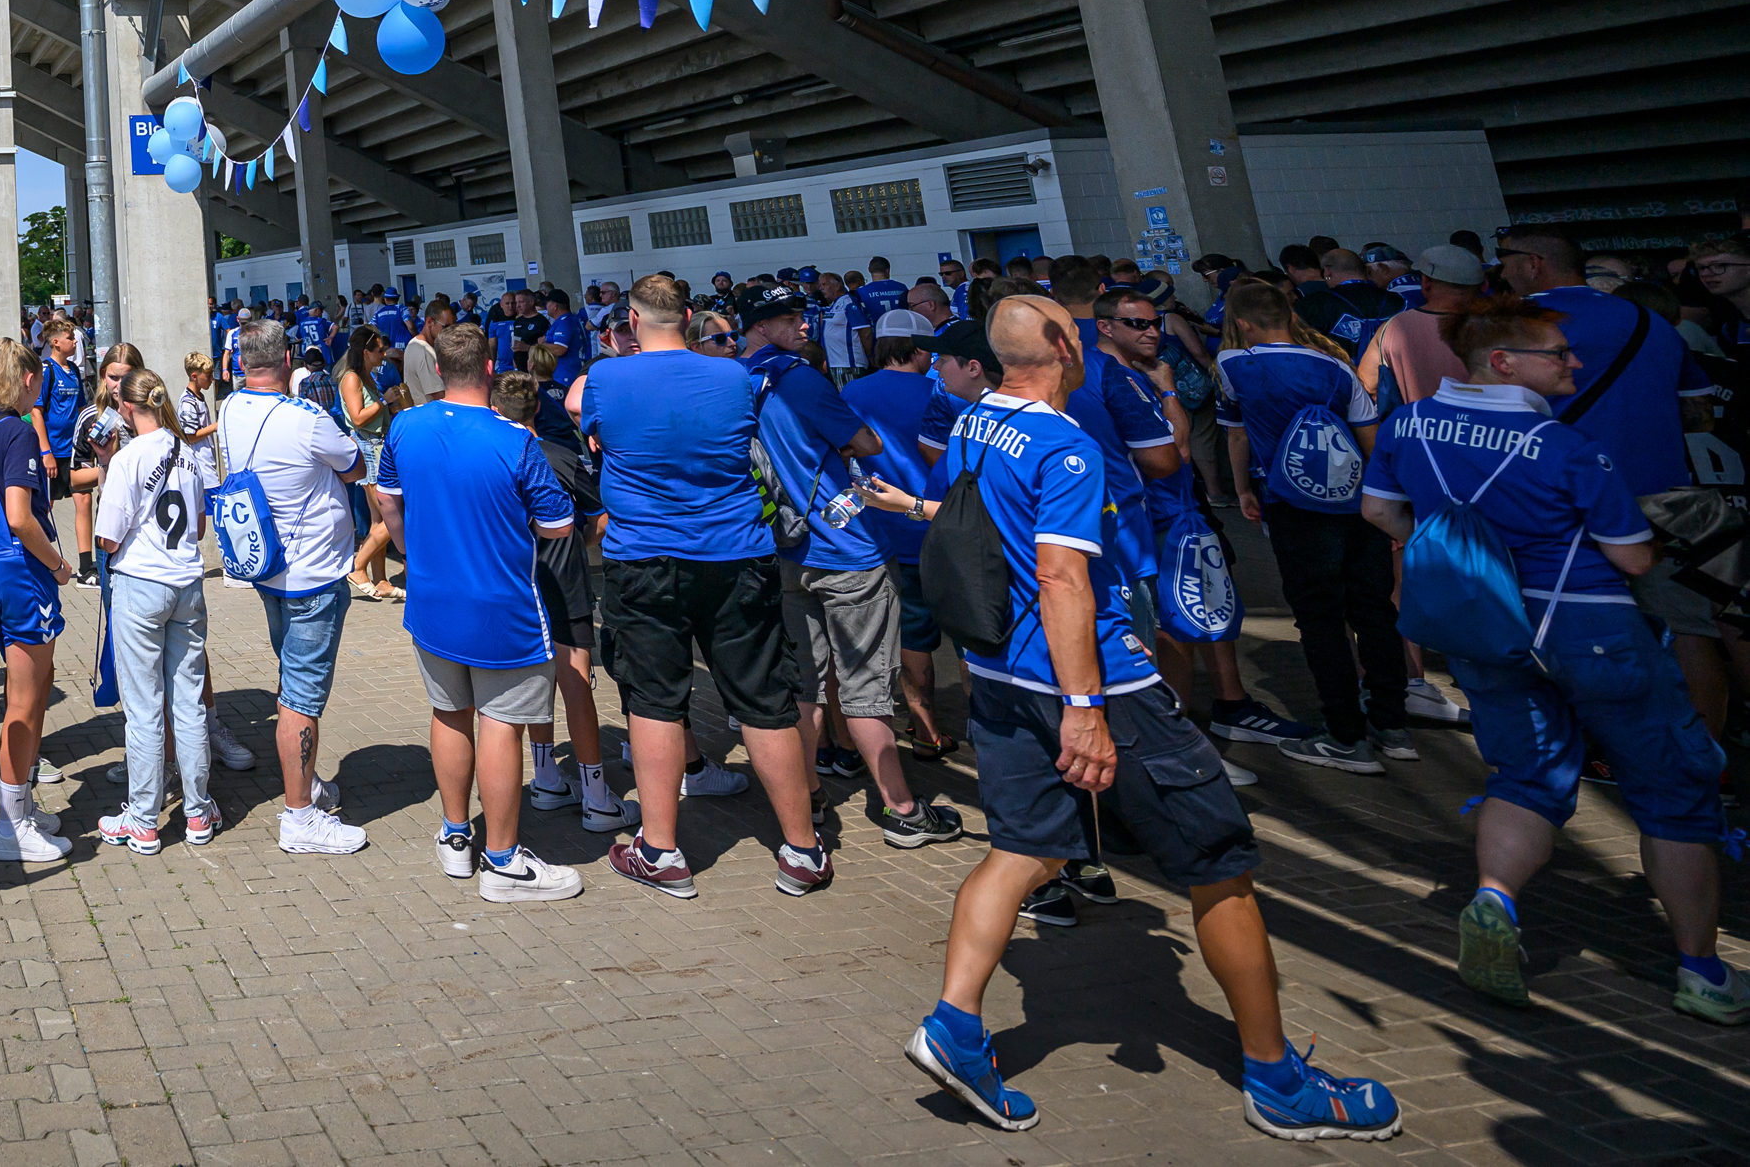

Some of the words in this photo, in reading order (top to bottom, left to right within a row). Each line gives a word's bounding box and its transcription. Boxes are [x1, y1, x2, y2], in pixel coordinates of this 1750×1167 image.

[1394, 416, 1544, 461] MAGDEBURG
[1288, 451, 1360, 498] MAGDEBURG
[155, 489, 188, 550] 9
[1182, 574, 1234, 627] MAGEBURG
